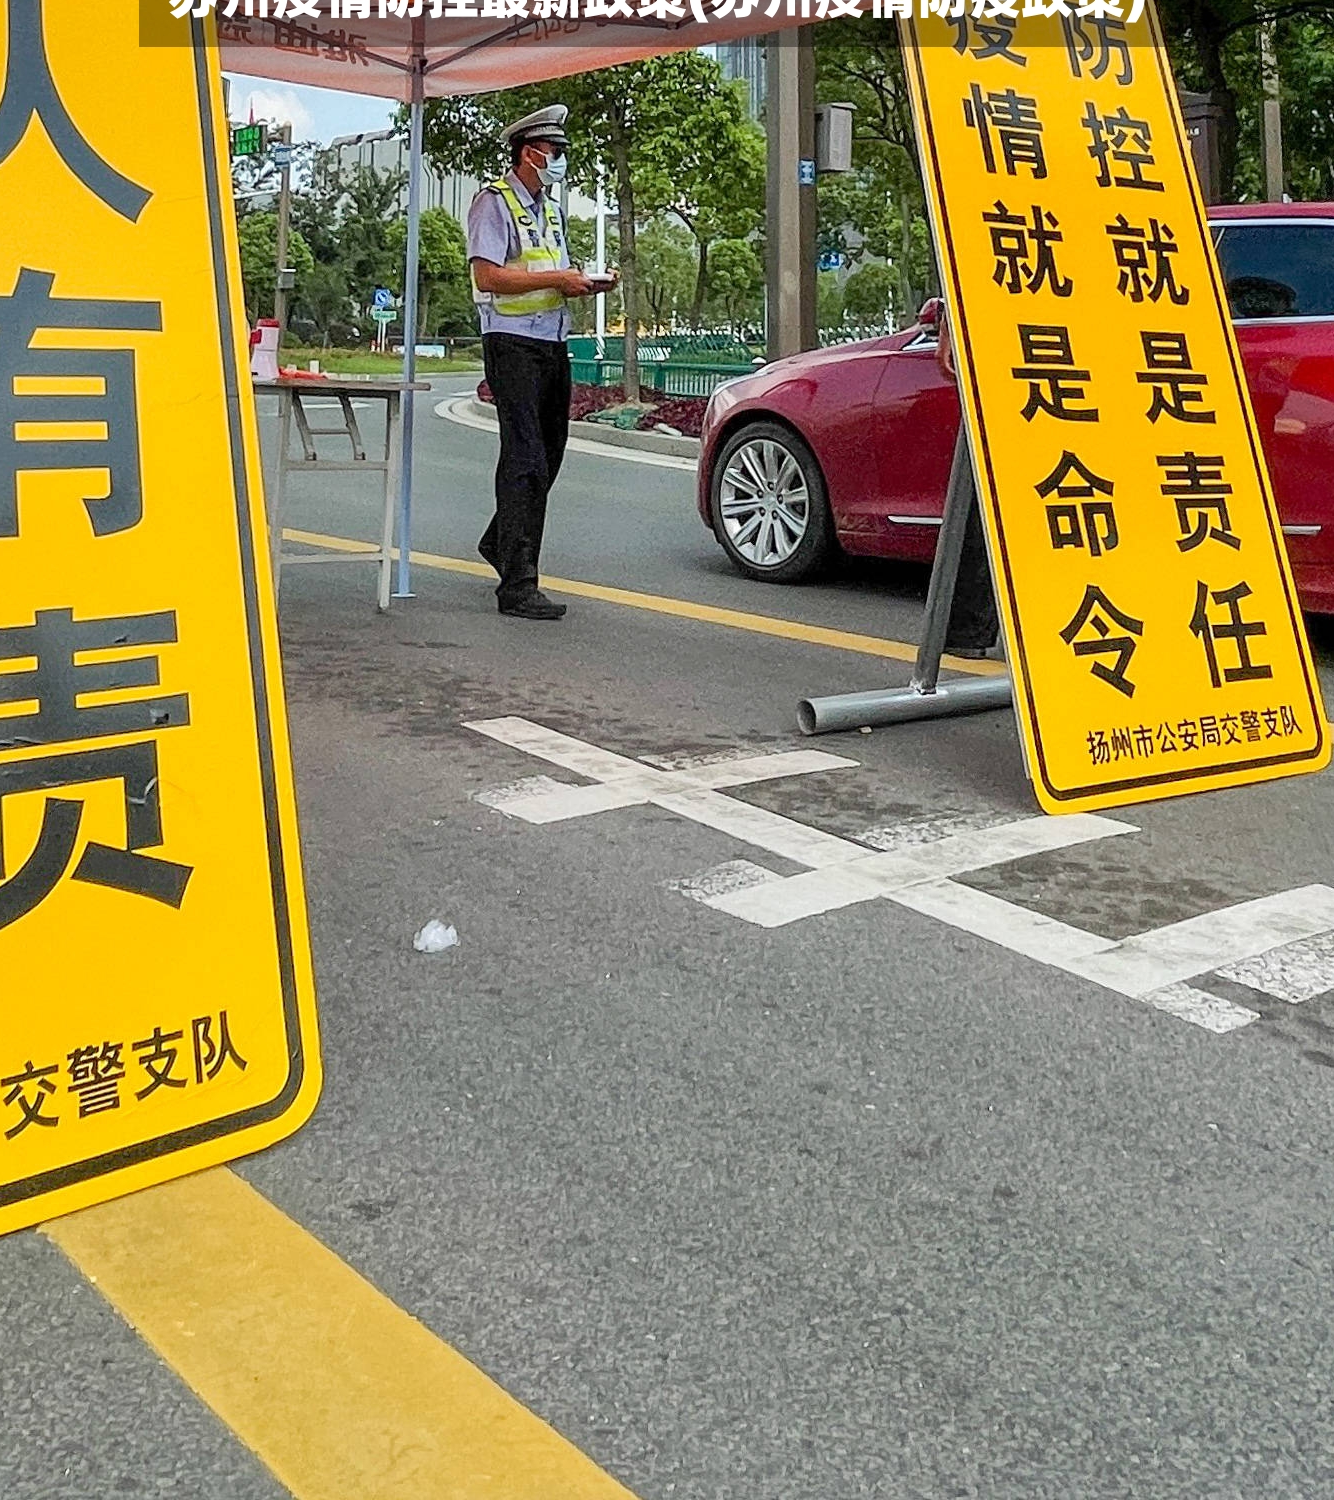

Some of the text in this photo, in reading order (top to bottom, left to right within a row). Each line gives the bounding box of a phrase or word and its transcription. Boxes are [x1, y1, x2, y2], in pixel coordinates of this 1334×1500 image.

[1057, 0, 1274, 689] 防控就是责任
[1086, 705, 1303, 766] 扬州市公安局交警支队
